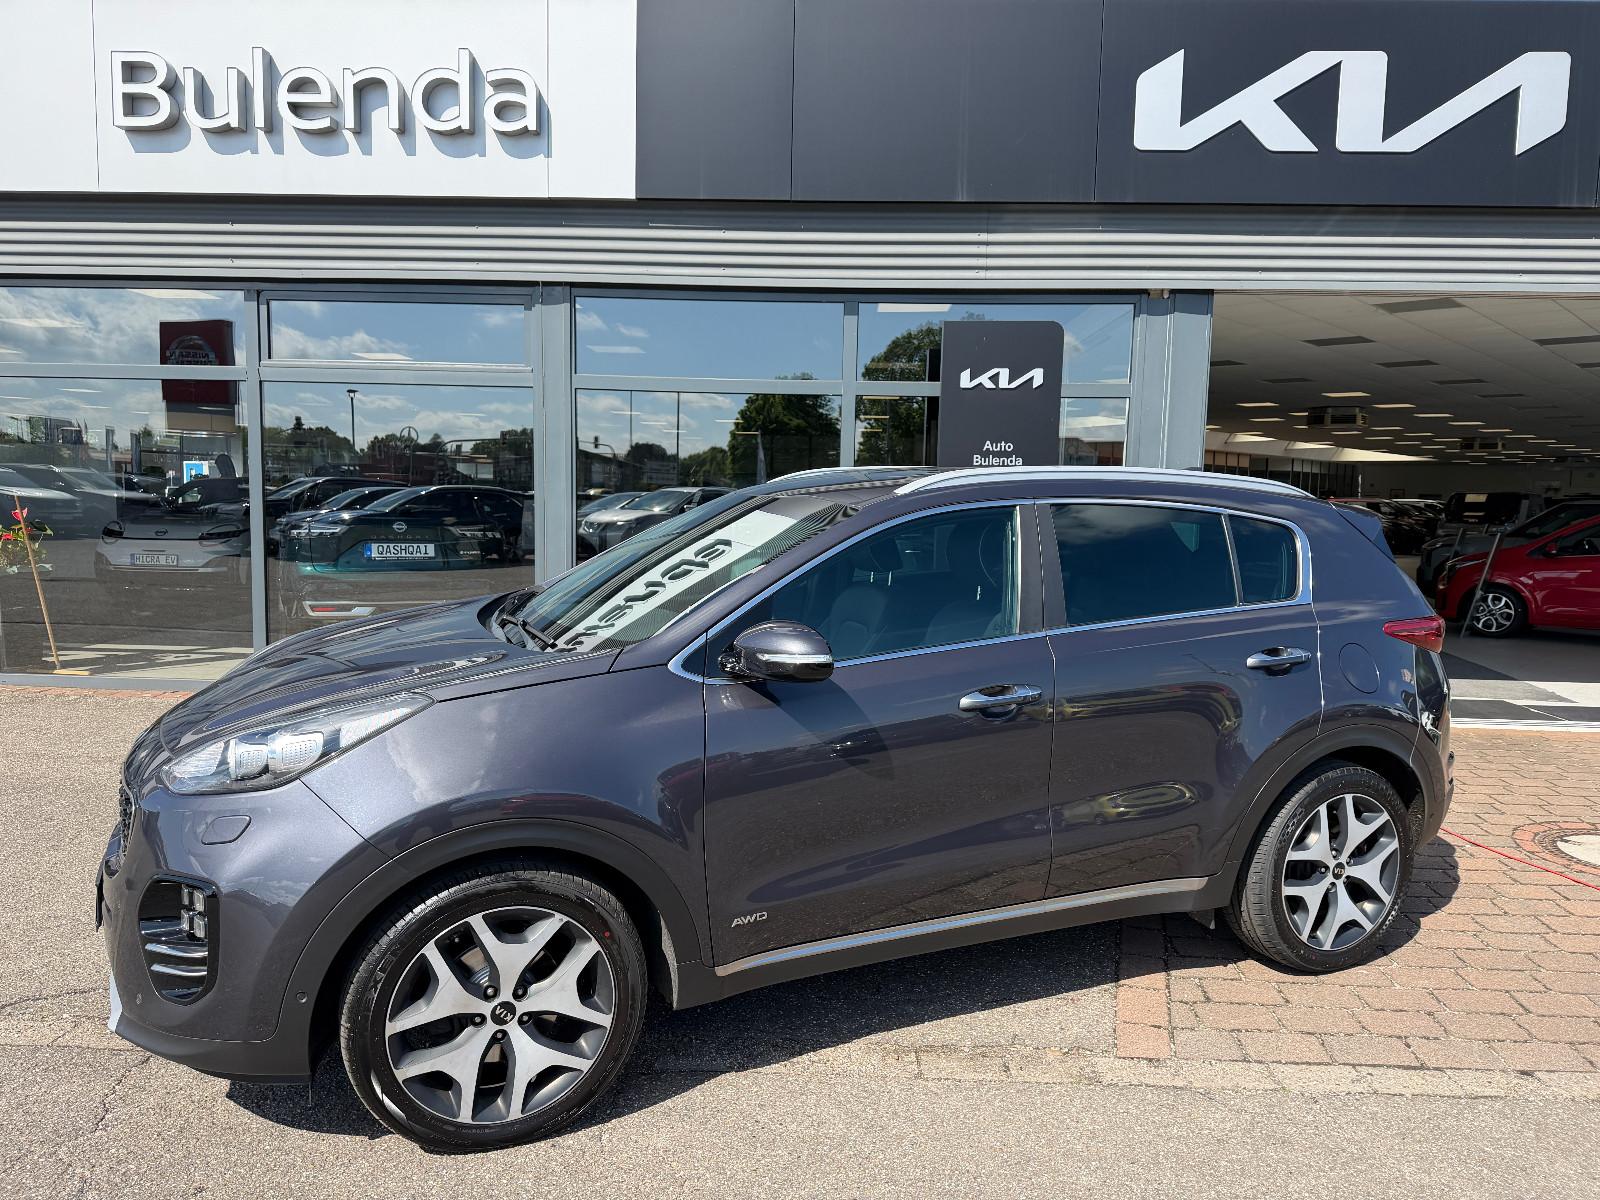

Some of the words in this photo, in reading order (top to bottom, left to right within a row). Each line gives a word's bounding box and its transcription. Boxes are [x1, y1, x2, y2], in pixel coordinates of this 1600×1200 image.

[110, 47, 541, 136] Bulenda
[1134, 49, 1571, 155] KIA
[960, 368, 1044, 389] KIA
[983, 440, 1014, 452] Auto
[973, 454, 1023, 466] Bulenda
[377, 544, 430, 556] QASHQAI
[731, 911, 768, 928] AWD
